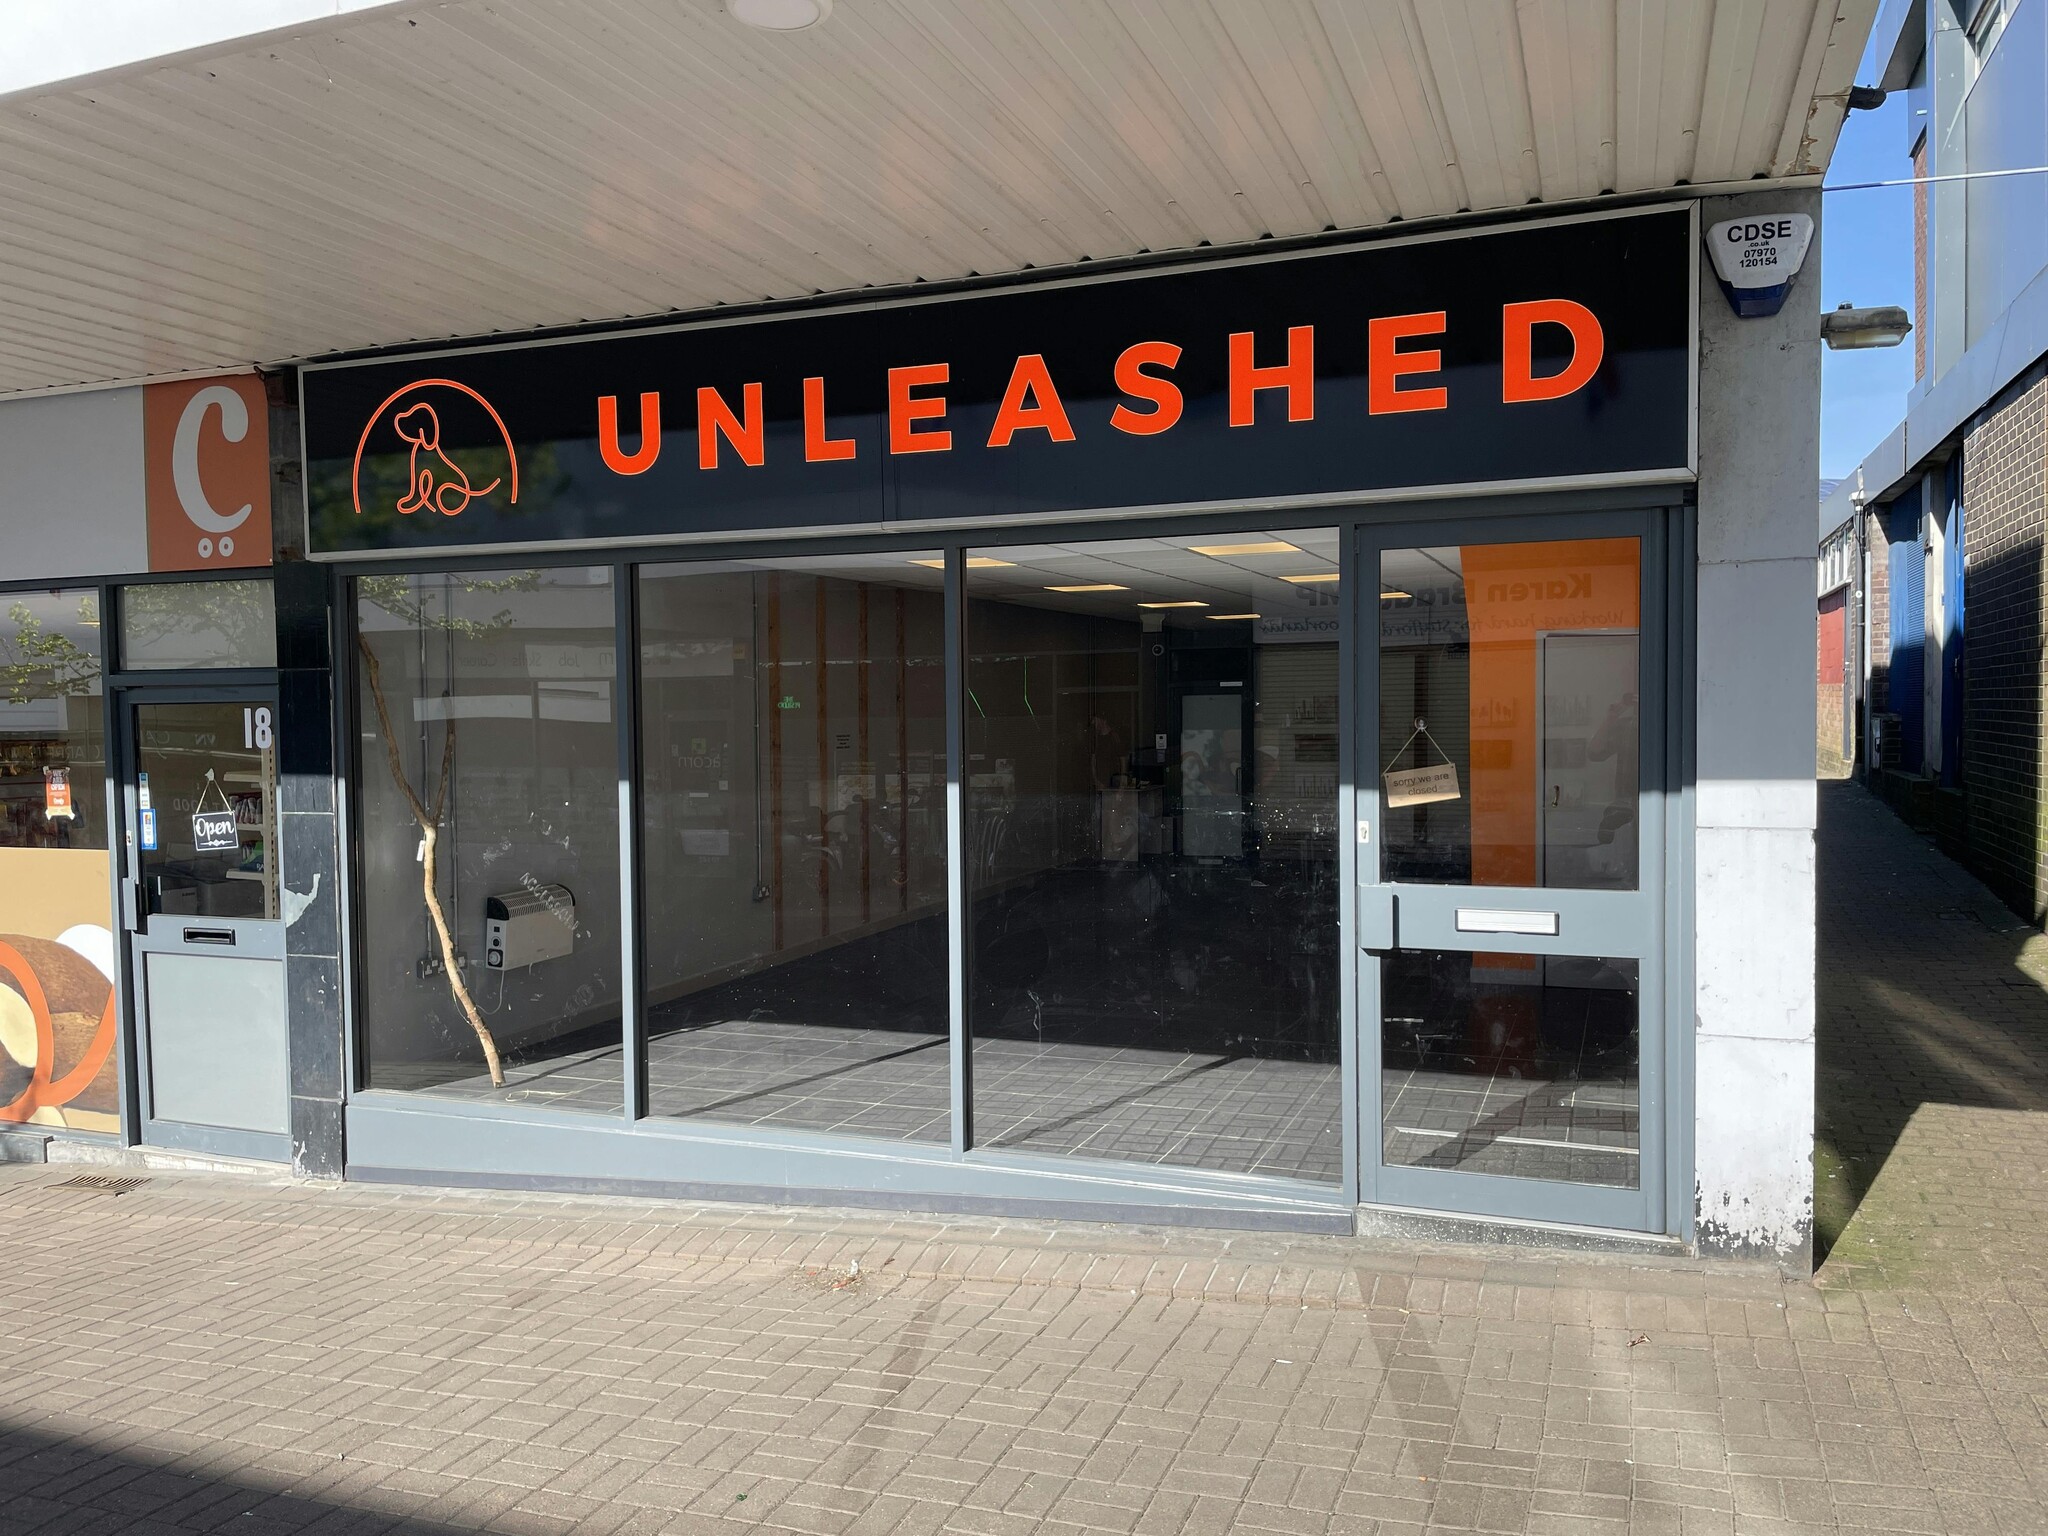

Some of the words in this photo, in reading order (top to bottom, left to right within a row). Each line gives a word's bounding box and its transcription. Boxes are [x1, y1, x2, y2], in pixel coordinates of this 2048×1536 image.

[1727, 220, 1792, 243] CDSE
[1747, 240, 1770, 248] .co.uk
[1743, 247, 1776, 259] 07970
[1739, 256, 1778, 268] 120154
[598, 299, 1604, 475] UNLEASHED
[243, 707, 272, 749] 18
[1393, 777, 1416, 787] sorry
[1417, 775, 1431, 783] we
[1434, 773, 1449, 782] are
[1408, 784, 1437, 796] closed
[195, 817, 235, 839] Open
